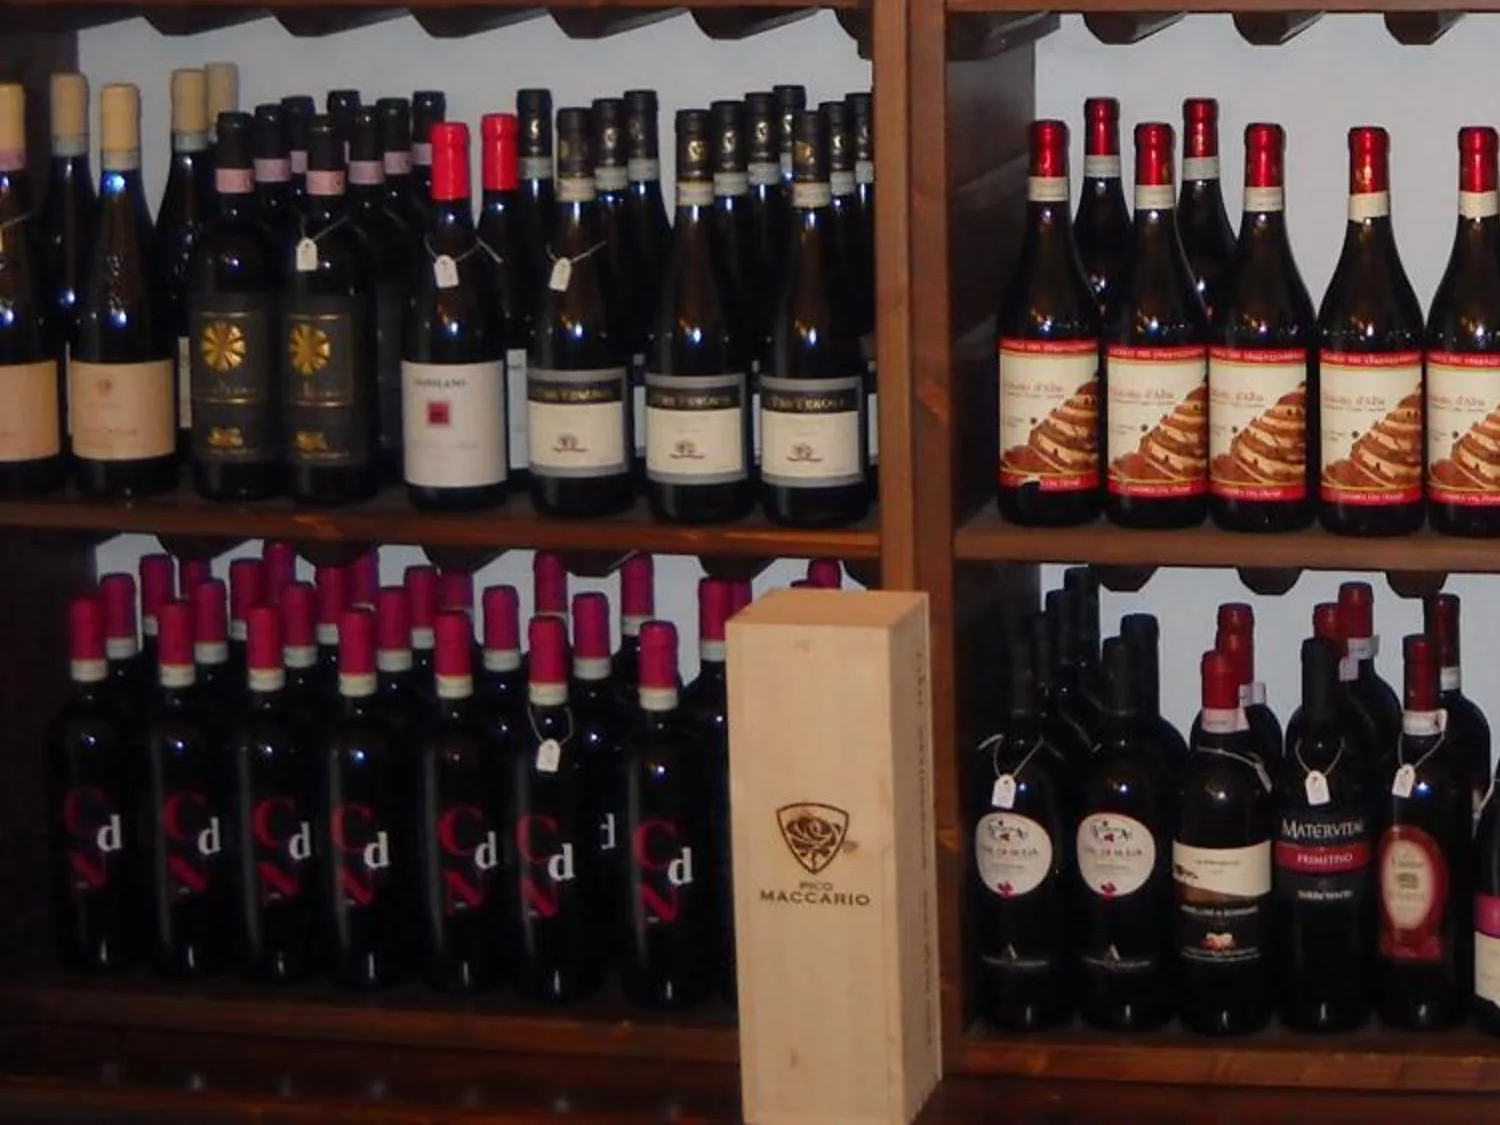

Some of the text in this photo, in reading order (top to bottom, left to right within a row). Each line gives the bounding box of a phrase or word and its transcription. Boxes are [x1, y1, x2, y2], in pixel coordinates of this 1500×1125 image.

[97, 815, 122, 851] d
[198, 817, 222, 854] d
[252, 797, 296, 846] C
[330, 803, 371, 852] C
[437, 806, 483, 855] C
[516, 813, 557, 864] C
[288, 822, 312, 860] d
[364, 831, 390, 869] d
[474, 831, 498, 869] d
[633, 819, 677, 870] C
[1296, 852, 1354, 866] PRIMITIVO
[257, 860, 299, 899] N
[548, 843, 574, 881] d
[667, 847, 694, 885] d
[335, 866, 378, 907] N
[443, 871, 484, 909] N
[520, 878, 559, 918] N
[638, 881, 680, 923] N
[759, 889, 871, 907] MACCARIO
[799, 881, 833, 891] PICO
